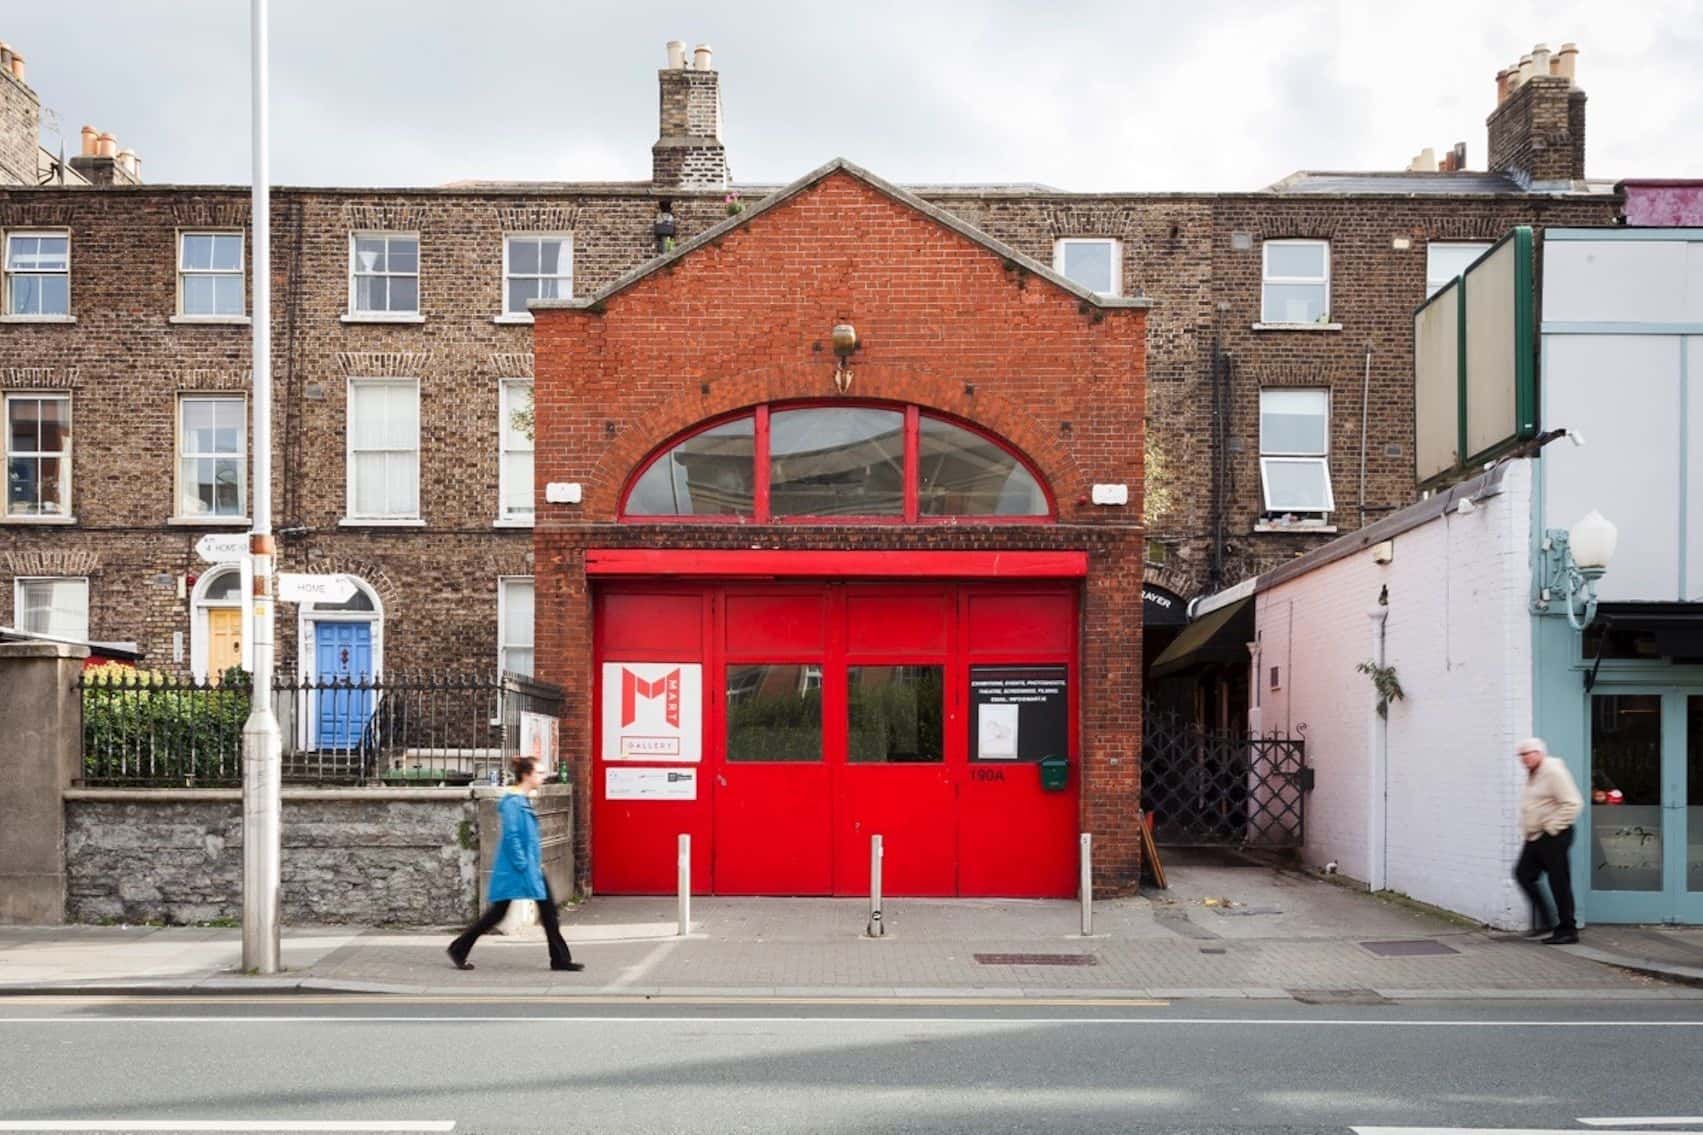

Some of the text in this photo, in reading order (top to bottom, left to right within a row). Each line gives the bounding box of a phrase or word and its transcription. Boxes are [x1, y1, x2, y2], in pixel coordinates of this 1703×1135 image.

[215, 544, 237, 552] HOME
[296, 583, 327, 593] HOME
[667, 679, 678, 721] MART
[627, 741, 672, 750] GALLERY
[969, 769, 1004, 781] 190A
